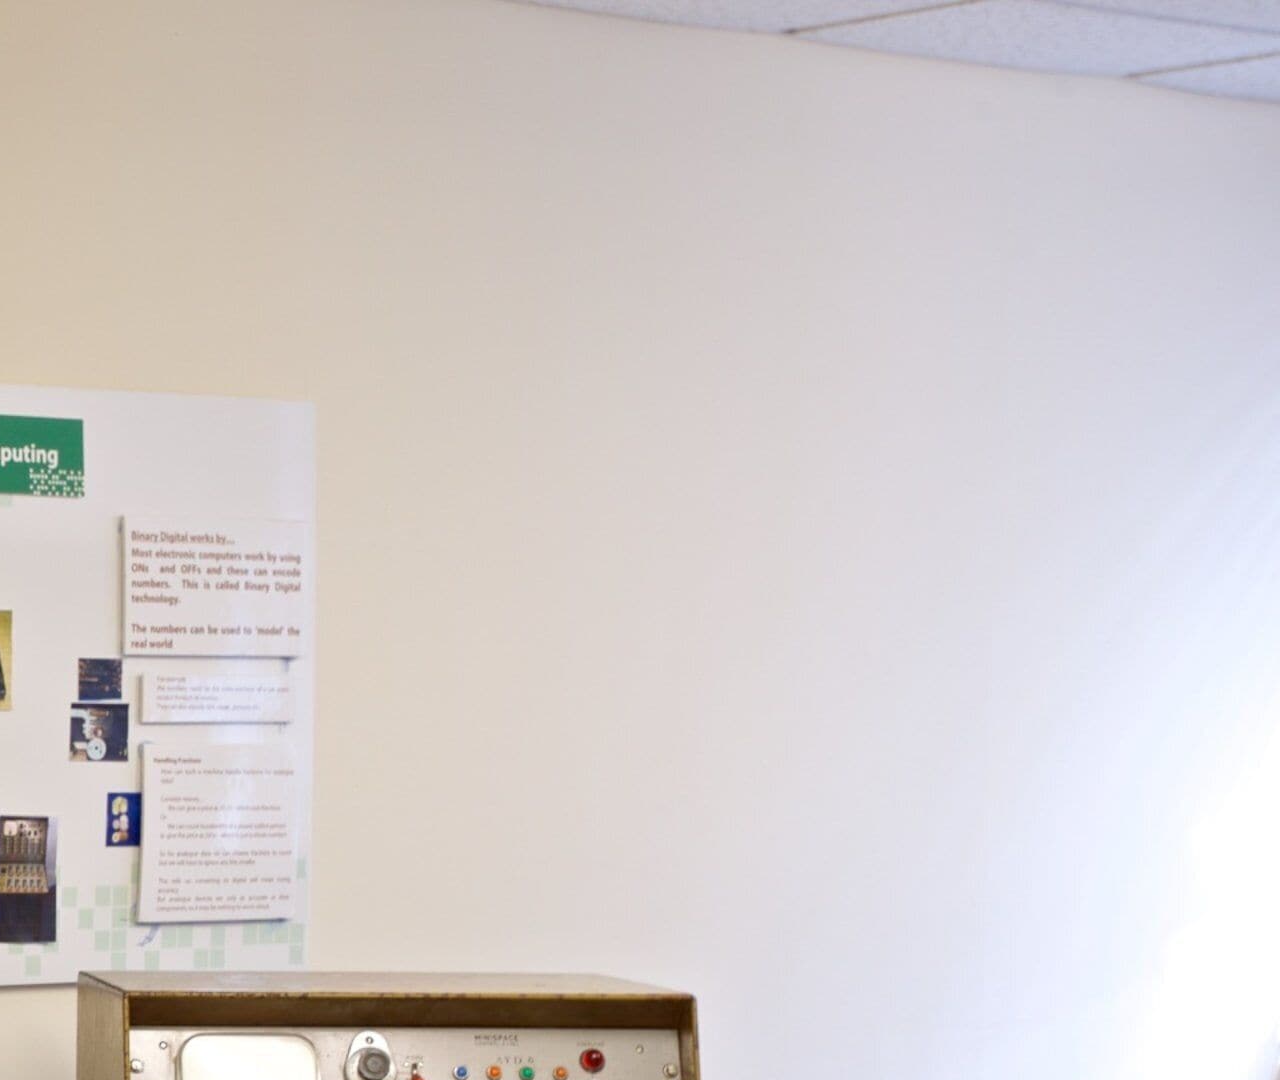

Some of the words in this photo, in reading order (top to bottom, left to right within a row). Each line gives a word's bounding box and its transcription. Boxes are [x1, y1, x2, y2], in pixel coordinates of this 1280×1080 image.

[131, 531, 158, 542] Binary
[161, 532, 188, 543] Digital
[190, 535, 214, 543] works
[132, 549, 152, 557] Most
[155, 550, 195, 559] electronic
[199, 552, 241, 561] computers
[245, 553, 263, 561] work
[267, 553, 276, 563] by
[280, 554, 300, 564] using
[160, 565, 175, 573] and
[206, 566, 222, 574] and
[227, 567, 249, 575] these
[254, 568, 268, 576] can
[272, 568, 300, 577] encode
[182, 580, 198, 589] This
[204, 581, 210, 589] is
[215, 582, 239, 590] called
[245, 582, 269, 593] Binary
[275, 582, 301, 593] Digital
[132, 624, 146, 632] The
[151, 625, 187, 633] numbers
[208, 626, 218, 634] be
[222, 626, 240, 634] used
[288, 627, 300, 635] the
[132, 640, 146, 648] real
[149, 640, 173, 648] world
